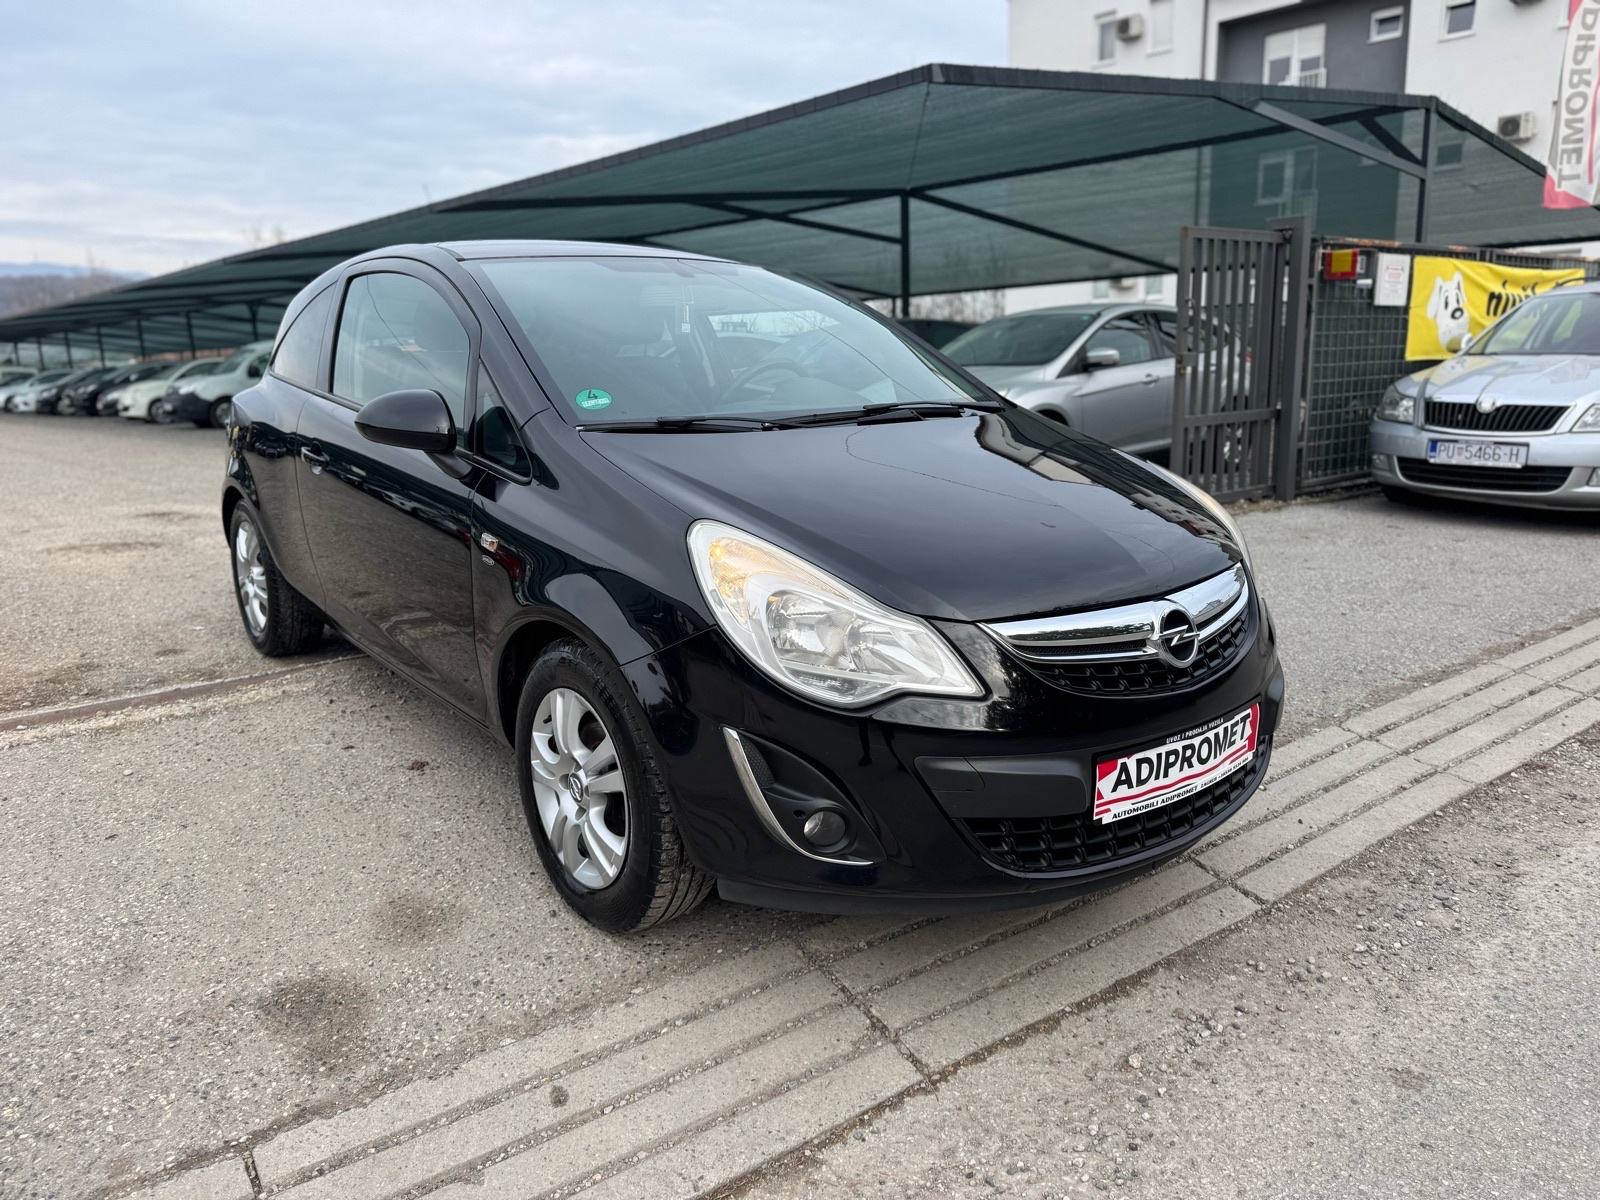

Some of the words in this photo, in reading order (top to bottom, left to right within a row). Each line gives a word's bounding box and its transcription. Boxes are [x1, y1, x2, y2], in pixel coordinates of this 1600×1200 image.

[587, 389, 599, 399] 4
[1438, 443, 1456, 459] PU
[1166, 734, 1181, 744] UVOZ
[1111, 712, 1250, 793] ADIPROMET
[1112, 801, 1159, 820] AUTOMOBILI
[1160, 785, 1199, 806] ADIPROMET
